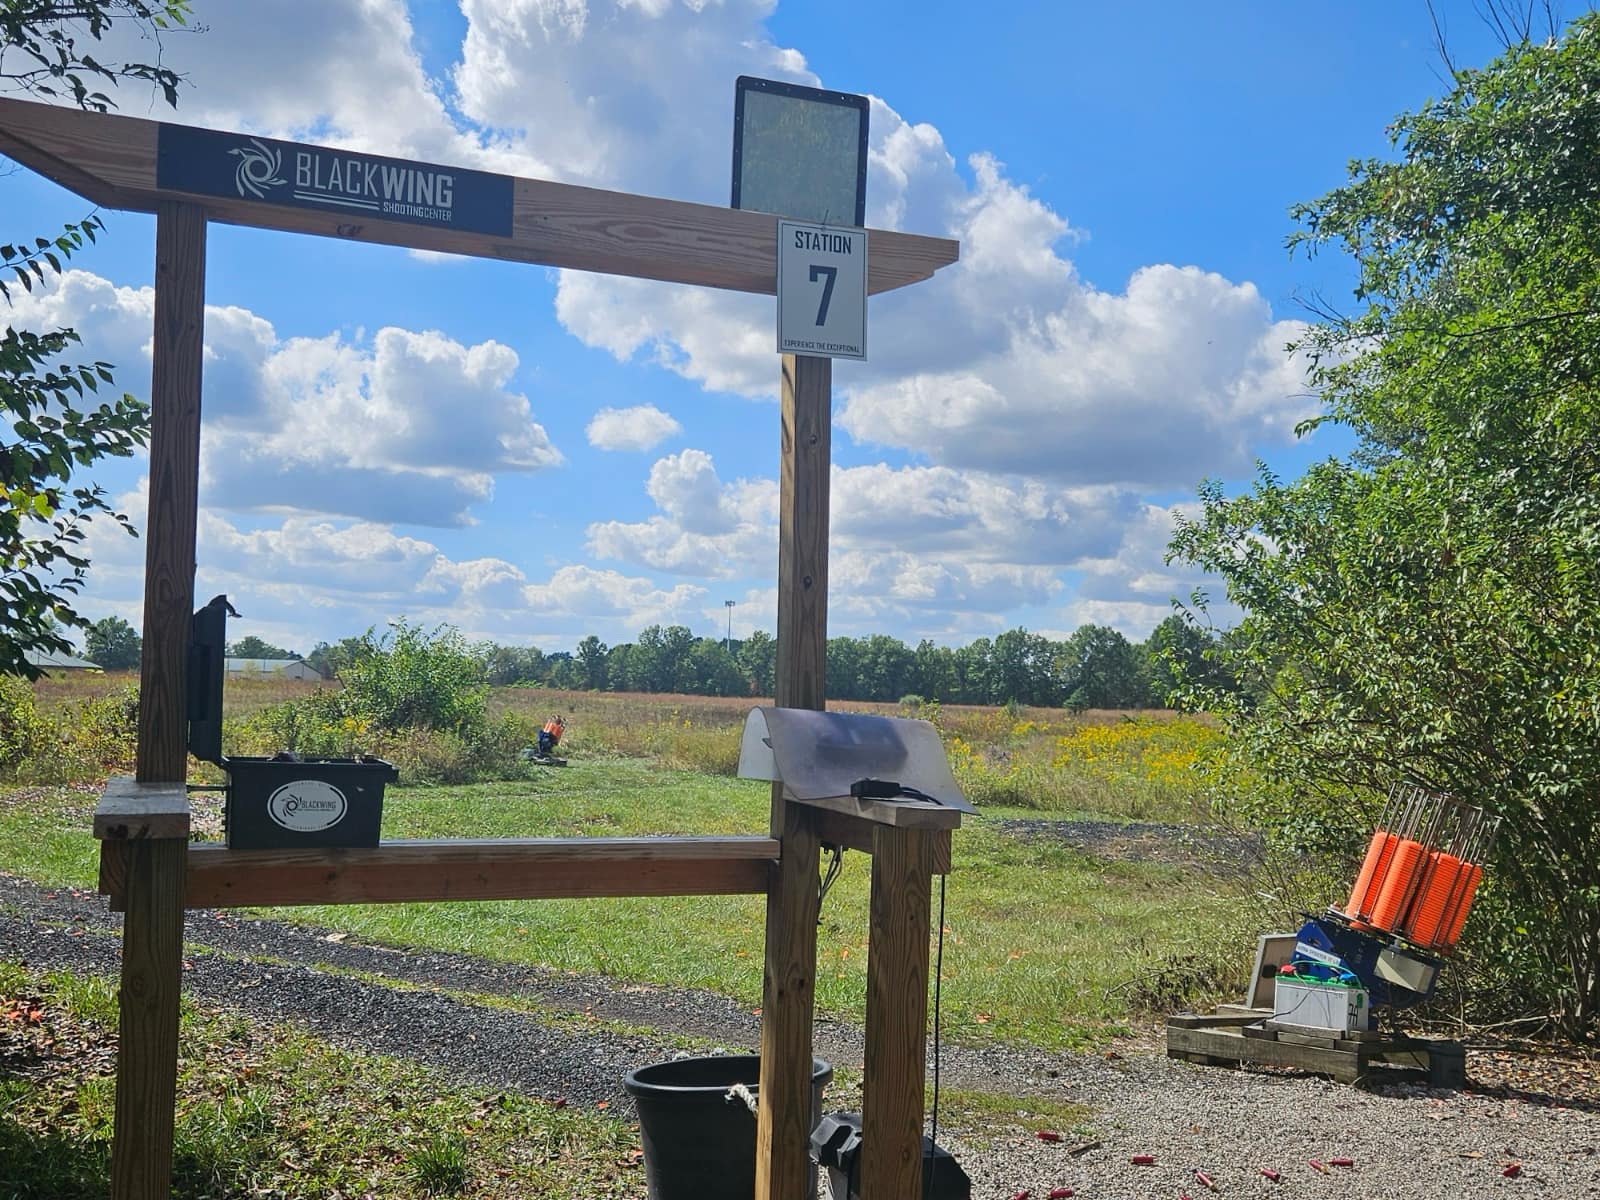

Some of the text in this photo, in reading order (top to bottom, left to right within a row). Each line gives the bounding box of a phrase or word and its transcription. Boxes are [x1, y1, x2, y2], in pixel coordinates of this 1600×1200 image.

[296, 152, 453, 209] BLACKWING
[795, 231, 852, 255] STATION
[809, 264, 838, 327] 7
[784, 339, 860, 354] EXPERIENCE THE EXCEPTIONAL
[301, 800, 337, 809] BLACKWING
